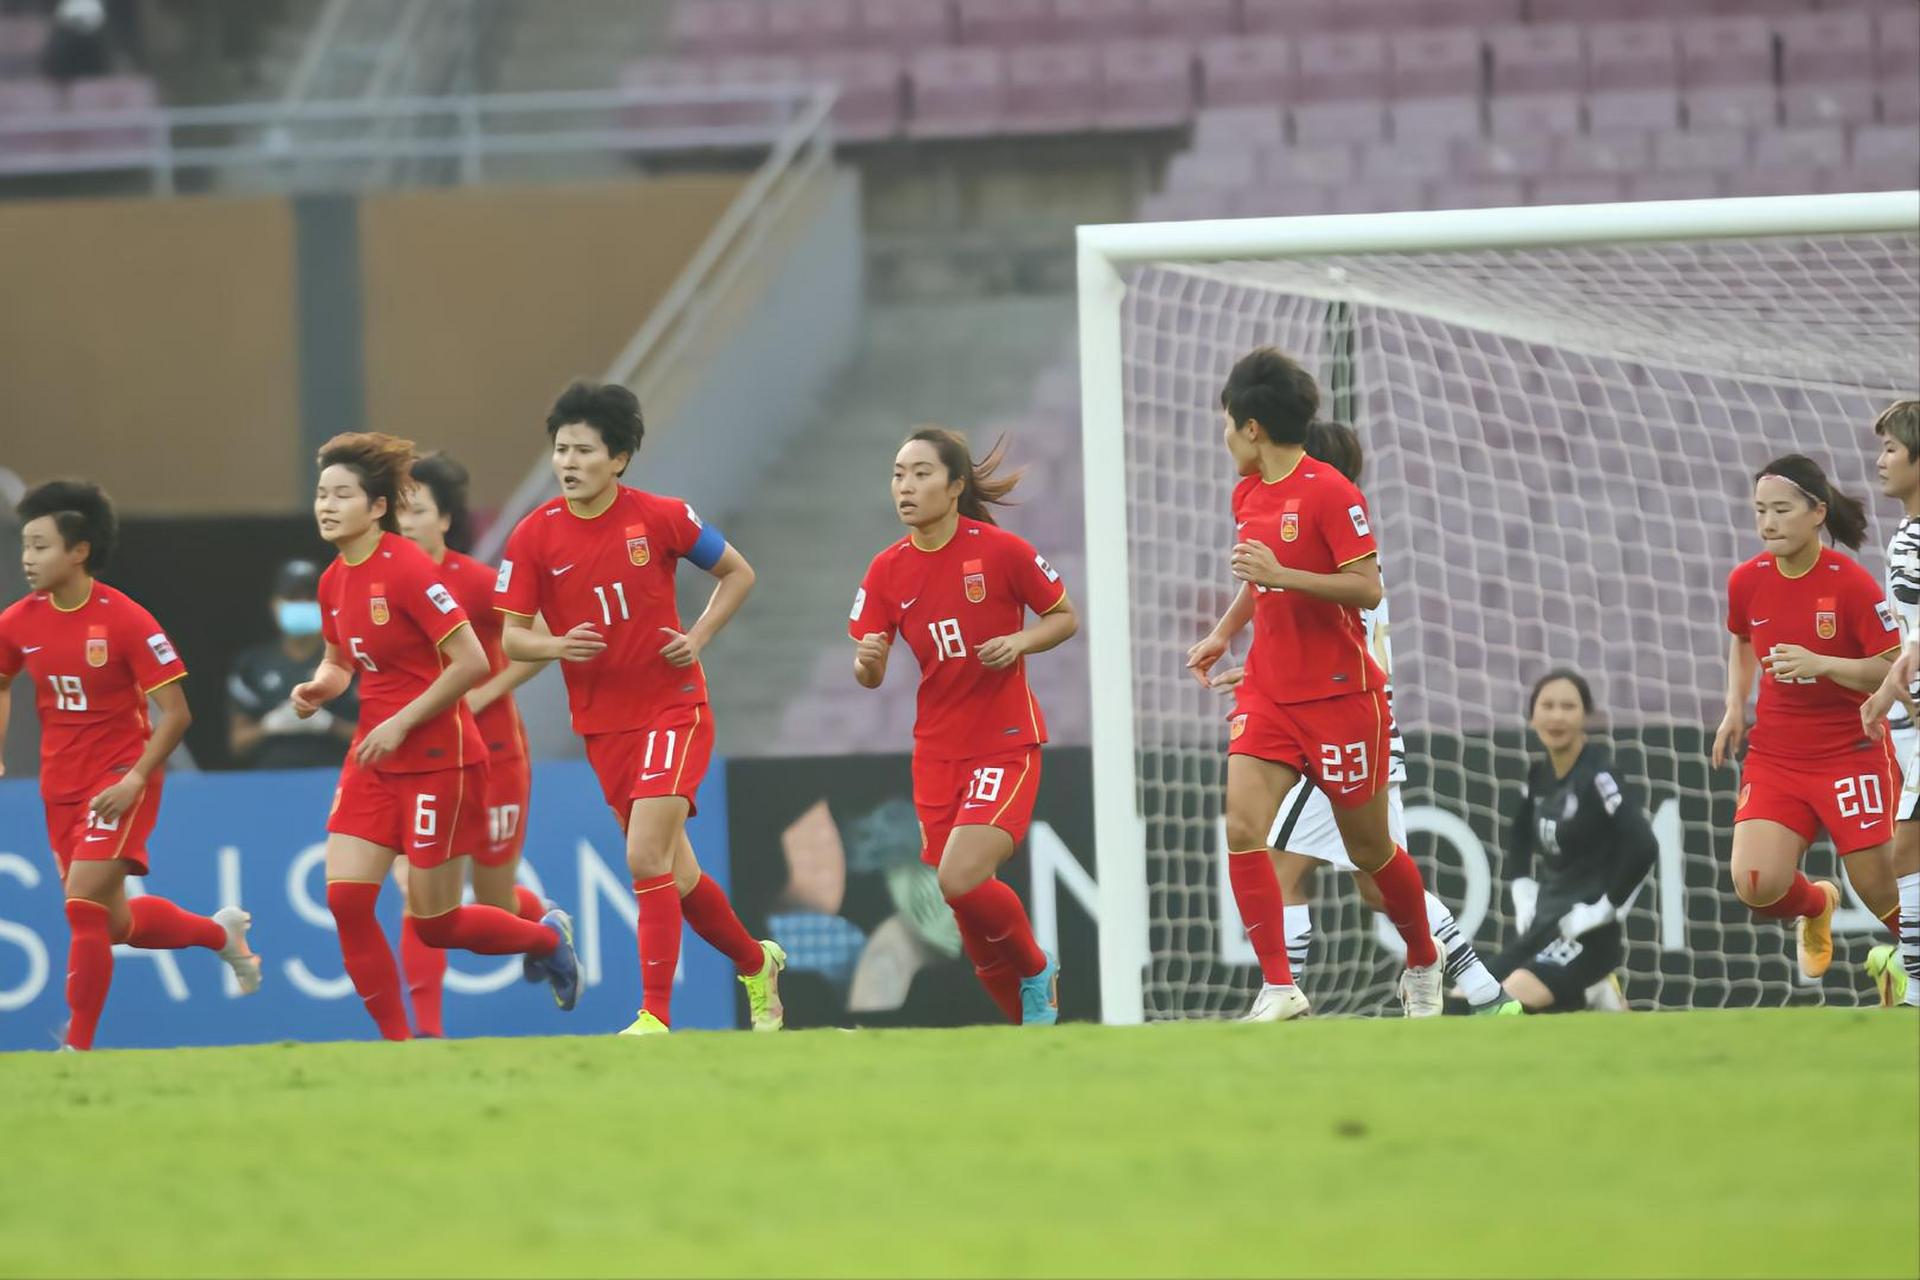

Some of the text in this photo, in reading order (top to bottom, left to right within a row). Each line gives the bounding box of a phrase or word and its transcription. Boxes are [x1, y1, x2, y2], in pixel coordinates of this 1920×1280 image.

[593, 582, 630, 626] 11
[928, 618, 967, 661] 18
[48, 674, 88, 711] 19
[644, 730, 676, 769] 11
[1321, 741, 1369, 782] 23
[968, 767, 1004, 802] 18
[1834, 774, 1883, 818] 20
[415, 793, 437, 836] 6
[488, 804, 520, 841] 10
